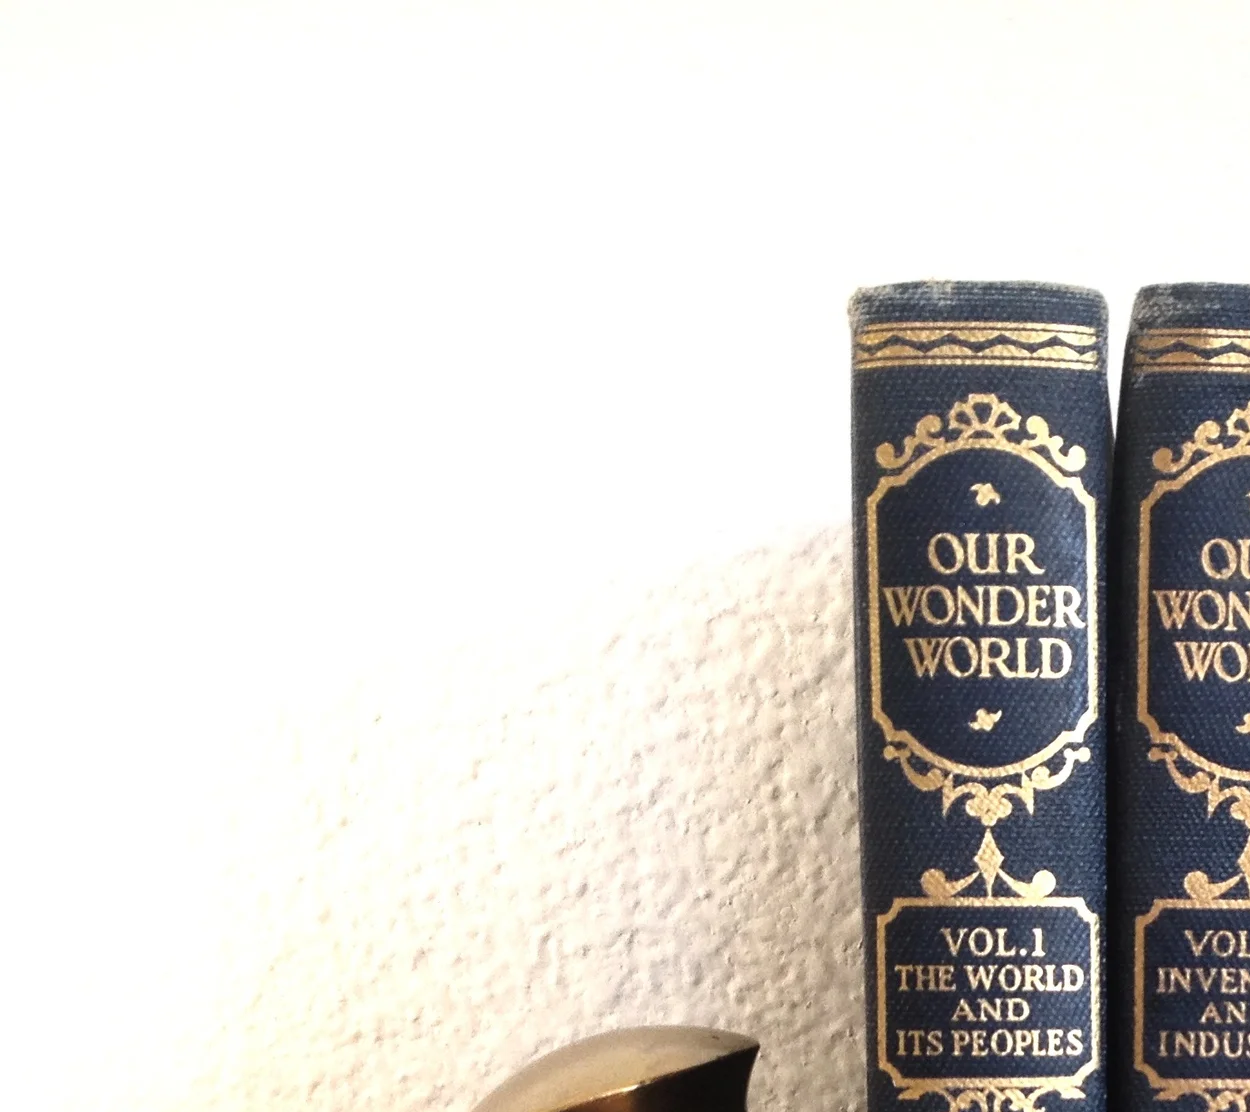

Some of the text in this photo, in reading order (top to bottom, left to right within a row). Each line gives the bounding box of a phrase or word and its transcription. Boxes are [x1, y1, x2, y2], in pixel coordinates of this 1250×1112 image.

[927, 532, 1045, 576] OUR
[883, 585, 1086, 629] WONDER
[904, 637, 1072, 679] WORLD
[894, 964, 1085, 992] THE WORLD
[951, 998, 1031, 1022] AND
[895, 1029, 1084, 1057] ITS PEOPLES
